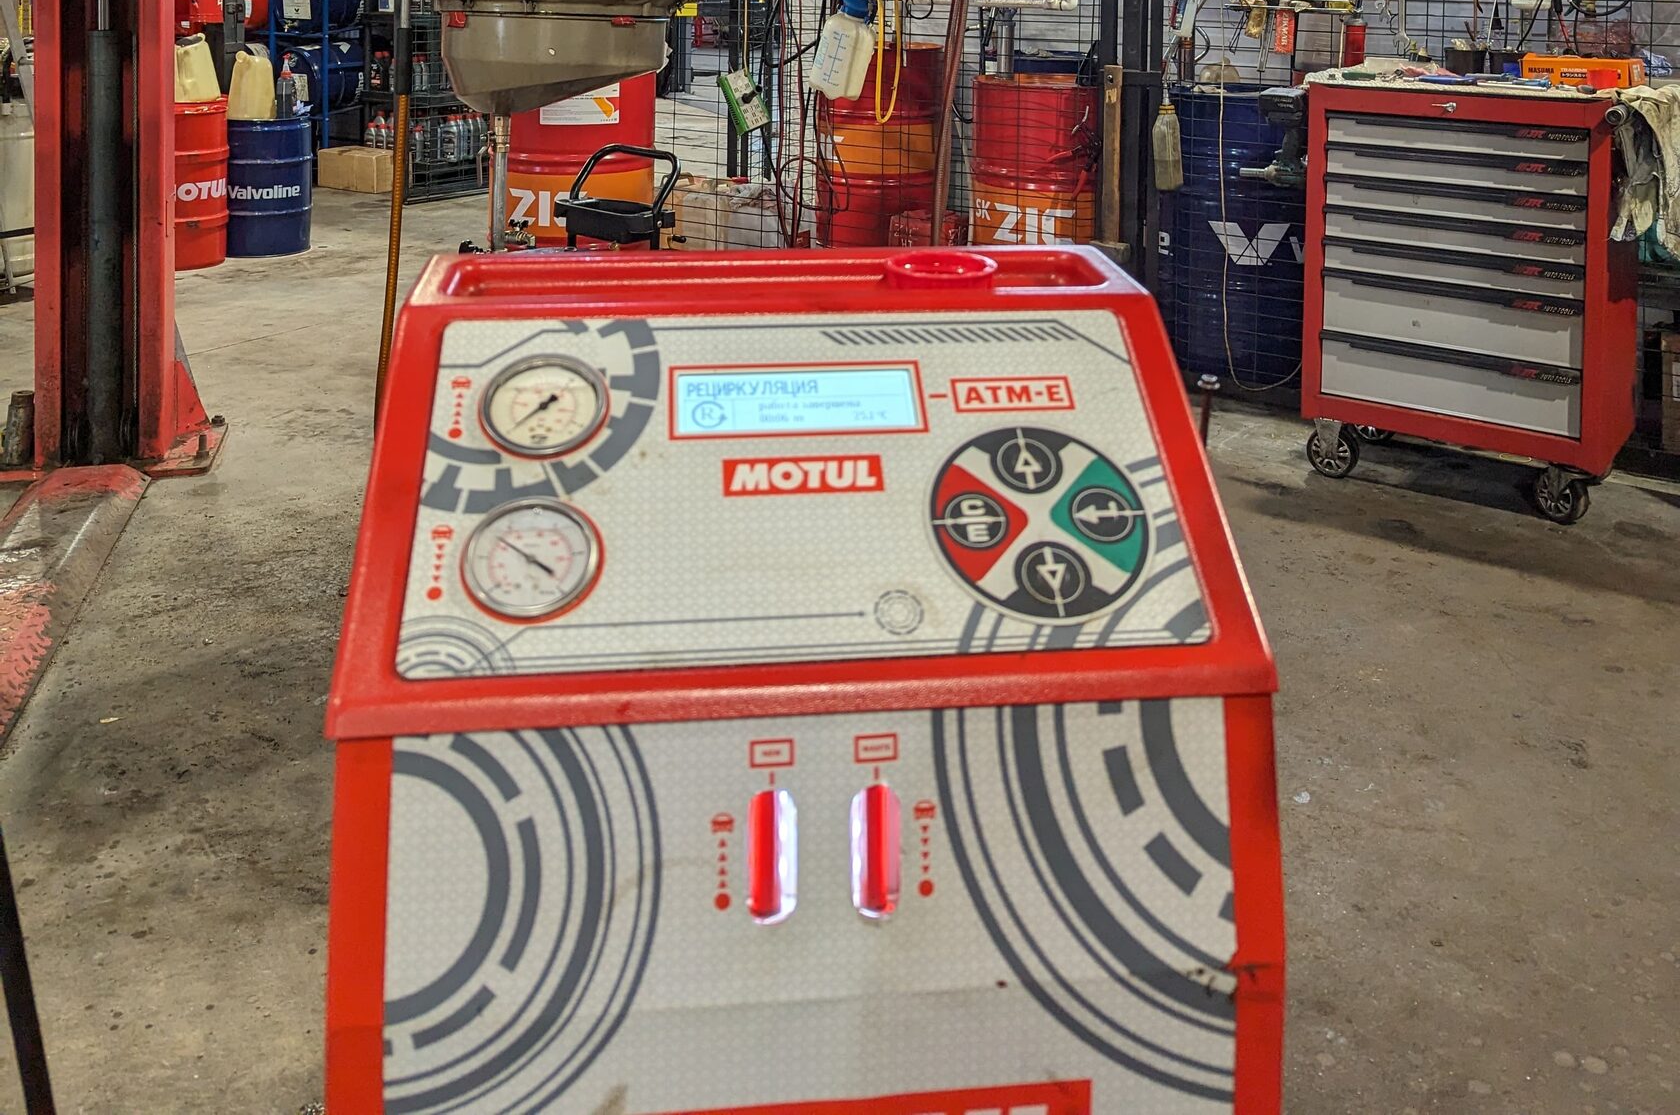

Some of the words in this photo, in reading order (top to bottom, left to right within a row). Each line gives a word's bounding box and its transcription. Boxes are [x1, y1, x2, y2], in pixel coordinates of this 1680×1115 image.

[174, 178, 226, 202] OTUL
[228, 184, 300, 200] Valvoline
[975, 198, 991, 221] SK
[686, 379, 819, 400] РЕЦИРКУЛЯЦИЯ
[964, 384, 1065, 405] ATM-E
[729, 459, 878, 492] MOTUL
[960, 498, 986, 516] C
[966, 523, 991, 543] E
